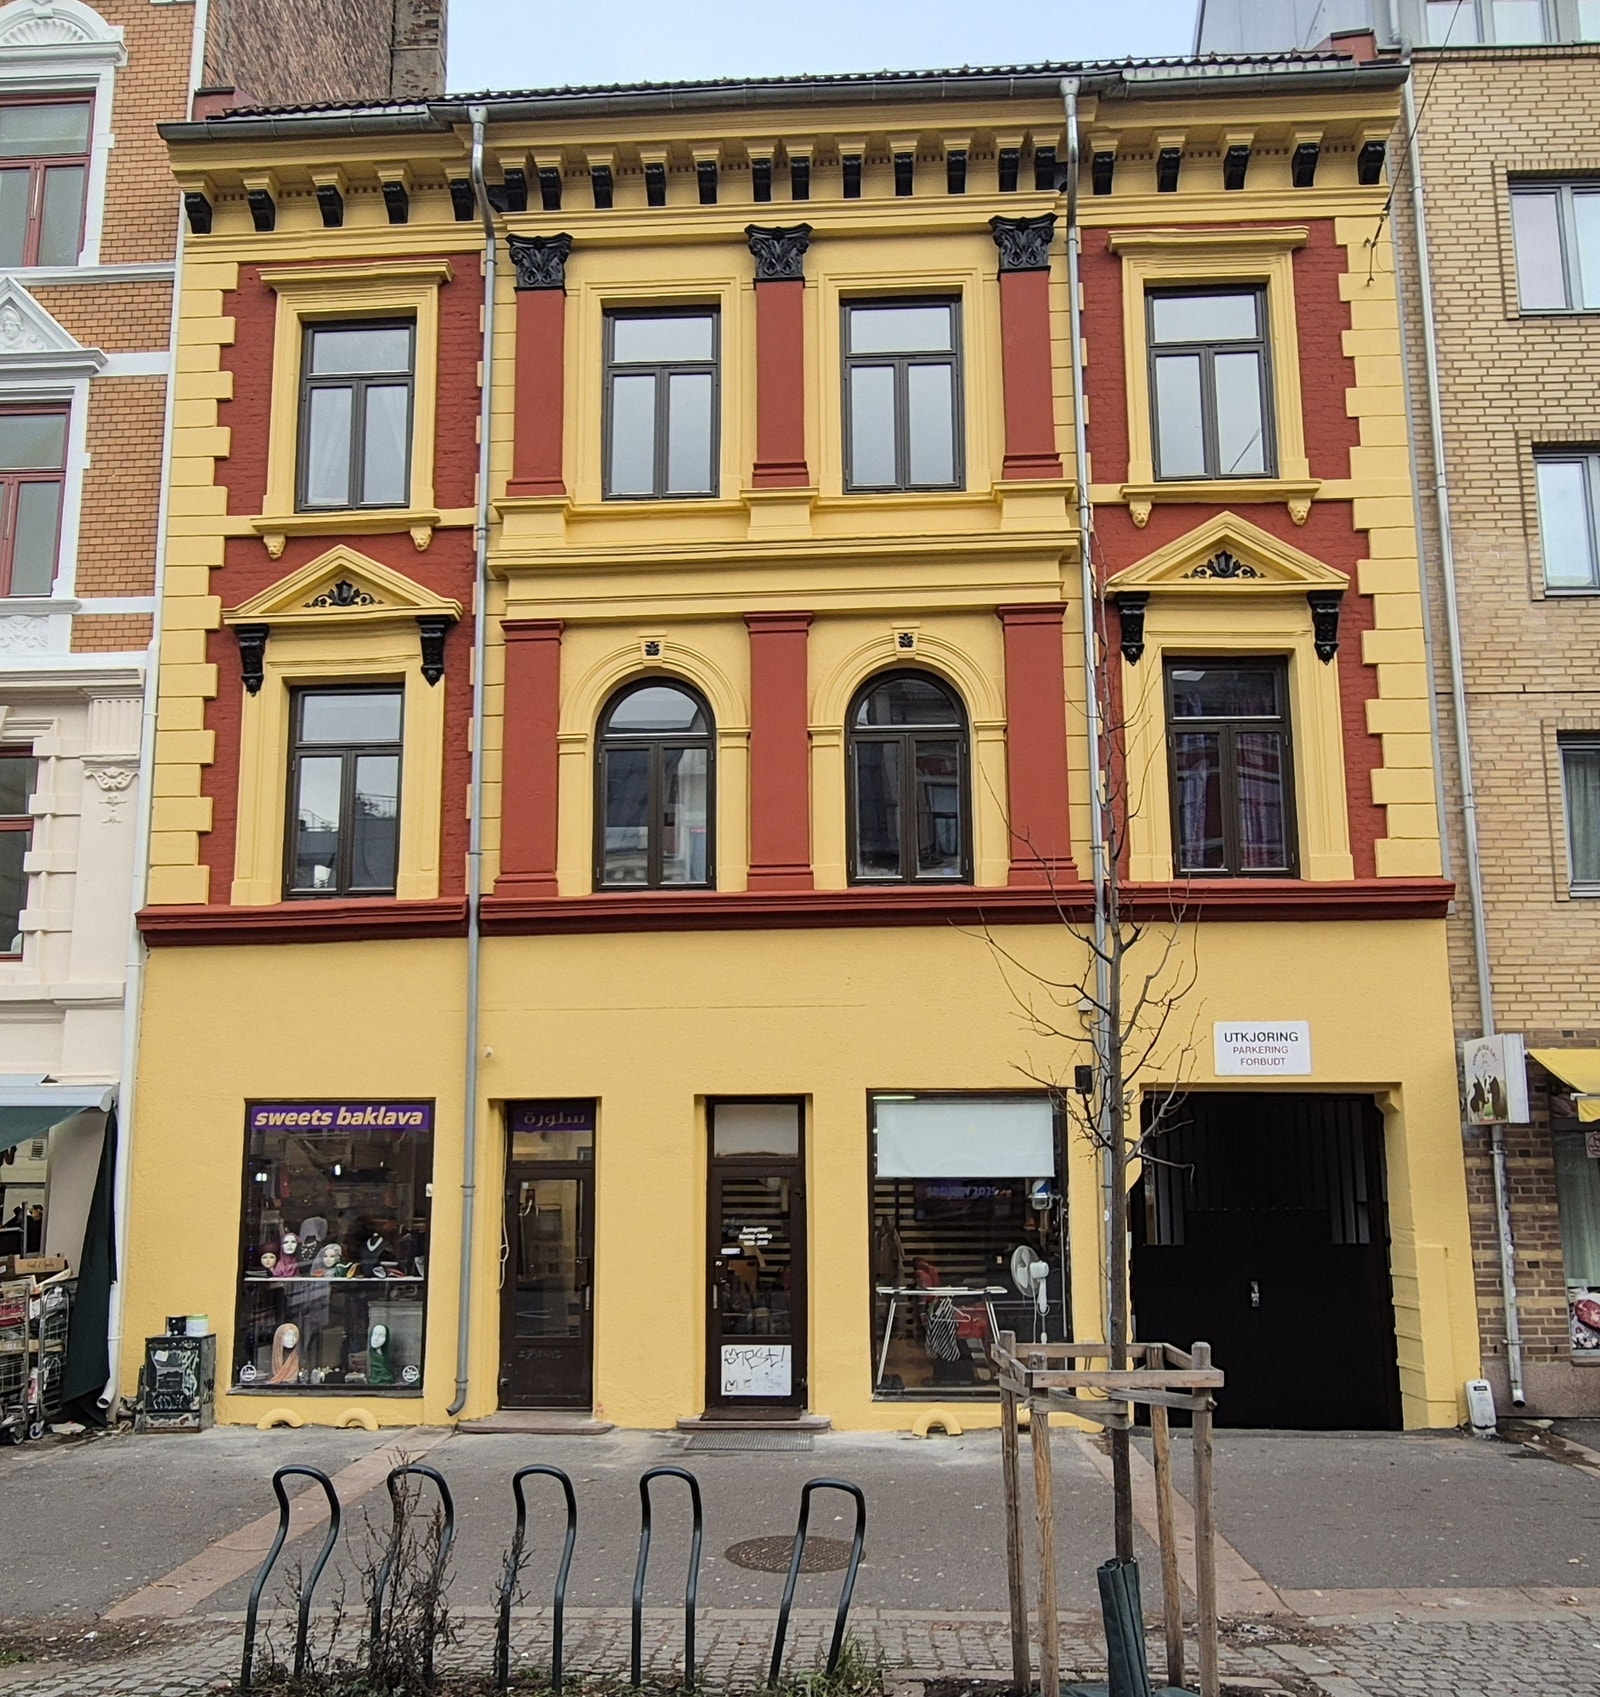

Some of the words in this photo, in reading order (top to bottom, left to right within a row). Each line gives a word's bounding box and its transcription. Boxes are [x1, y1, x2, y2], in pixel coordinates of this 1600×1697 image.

[1224, 1031, 1299, 1043] UTKJØRING
[1232, 1045, 1289, 1055] PARKERING
[1240, 1057, 1286, 1066] FORBUDT
[254, 1108, 333, 1127] sweets
[336, 1106, 423, 1126] baklava
